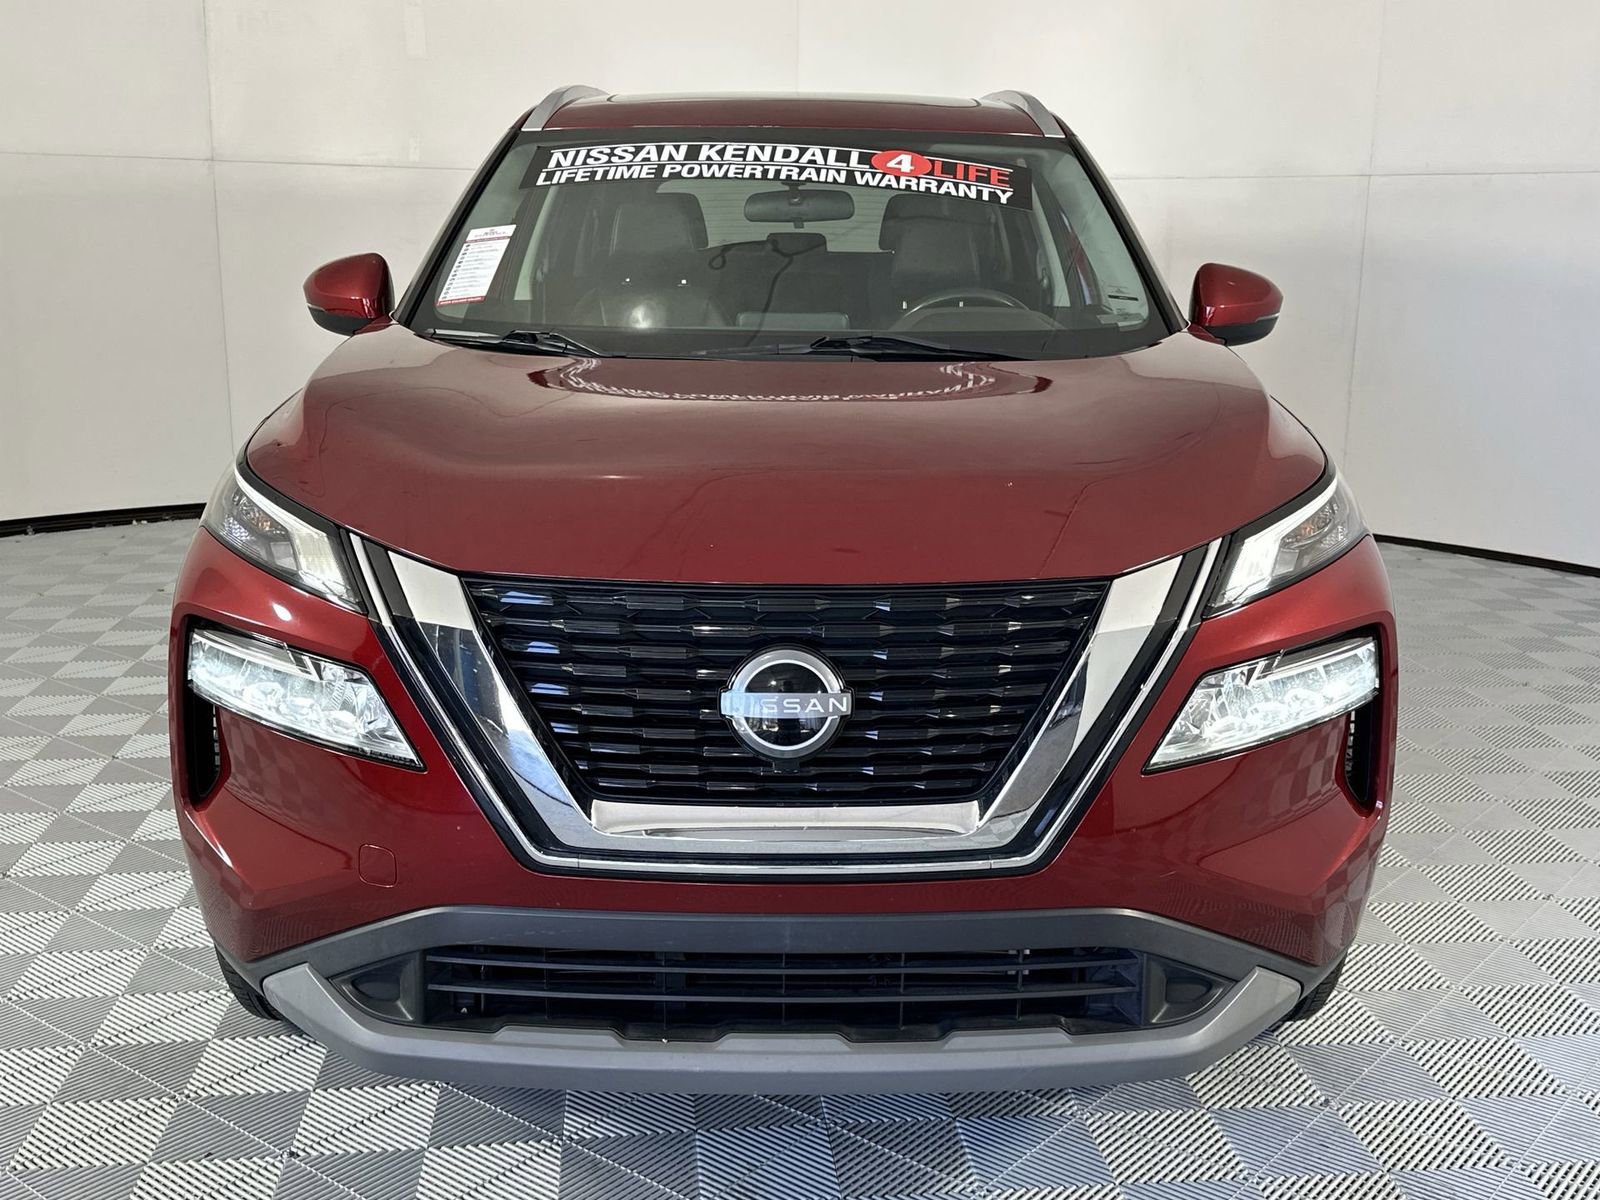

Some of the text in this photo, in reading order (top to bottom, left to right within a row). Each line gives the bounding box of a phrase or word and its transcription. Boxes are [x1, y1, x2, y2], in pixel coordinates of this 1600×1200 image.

[536, 164, 1013, 205] LIFETIME POWERTRAIN WARRANTY
[548, 144, 1010, 187] NISSAN KENDALL 4 LIFE
[725, 696, 847, 713] ISSAN
